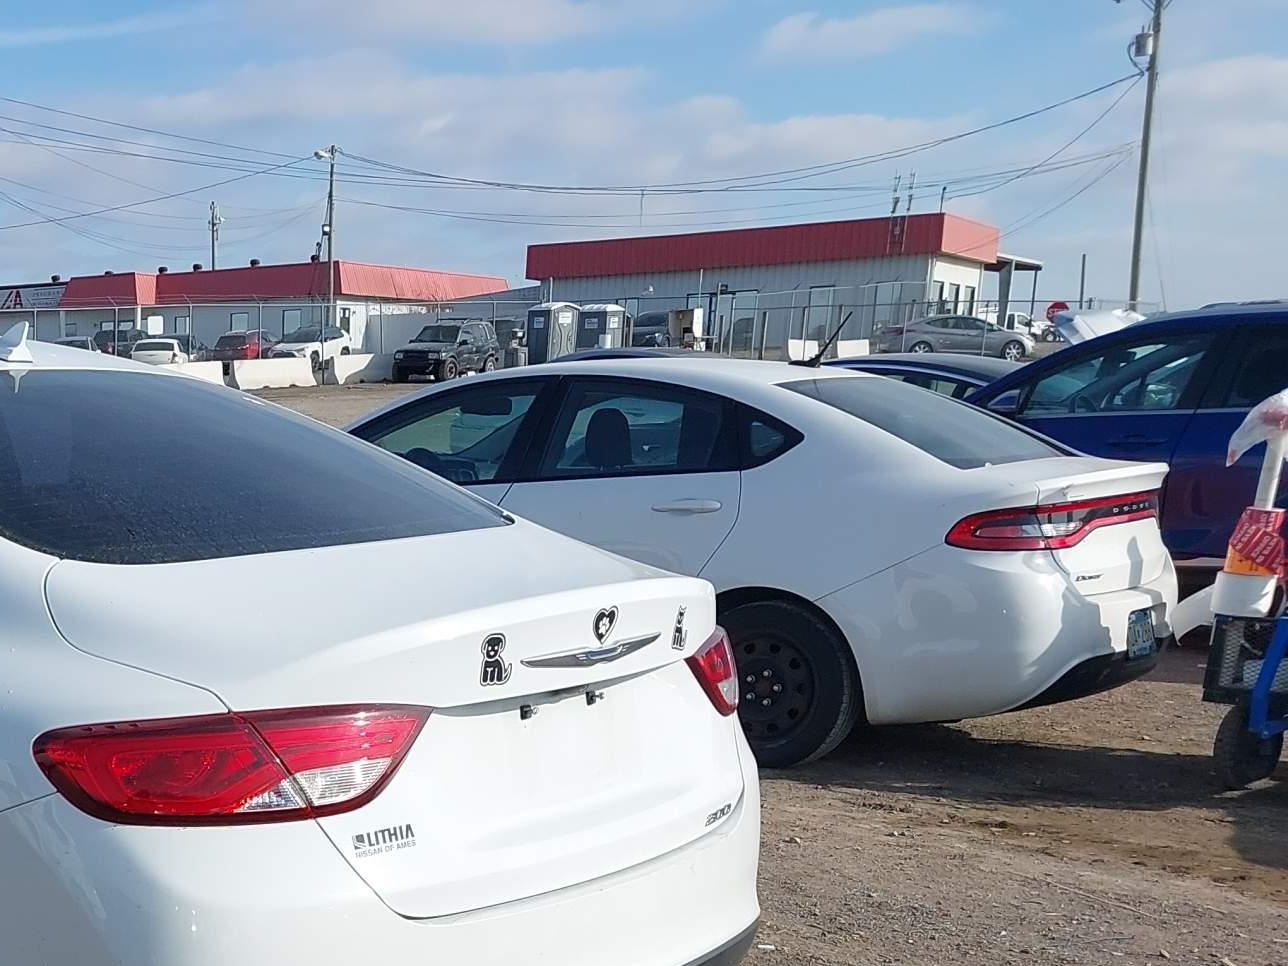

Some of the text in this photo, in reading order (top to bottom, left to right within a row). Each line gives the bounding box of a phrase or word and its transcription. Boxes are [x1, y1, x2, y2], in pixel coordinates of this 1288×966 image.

[366, 823, 415, 847] LITHIA
[355, 839, 416, 859] NISSAN OF AMES
